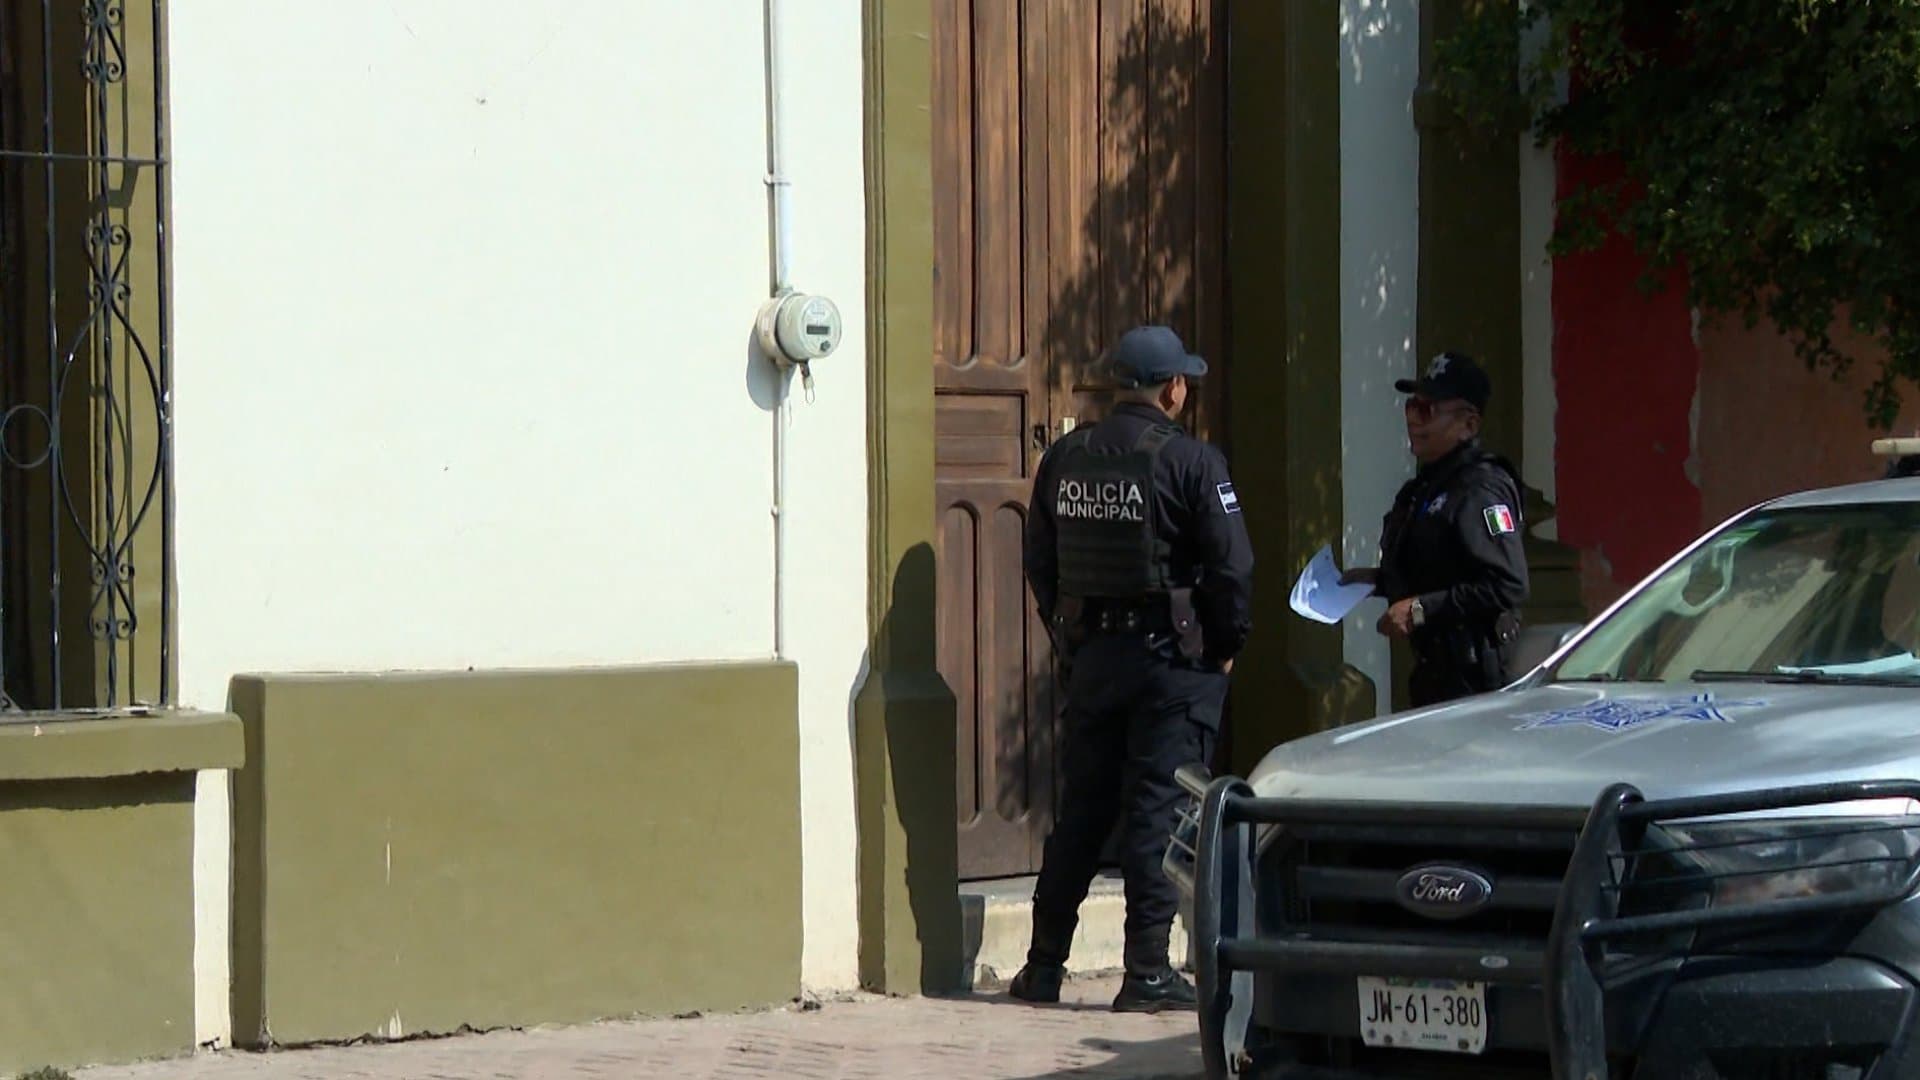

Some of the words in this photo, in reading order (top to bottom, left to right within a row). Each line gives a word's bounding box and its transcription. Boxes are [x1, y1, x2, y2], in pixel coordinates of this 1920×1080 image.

[1057, 479, 1143, 504] POLICÍA
[1057, 501, 1143, 520] MUNICIPAL
[1413, 874, 1465, 901] Ford
[1367, 989, 1480, 1028] JW-61-380
